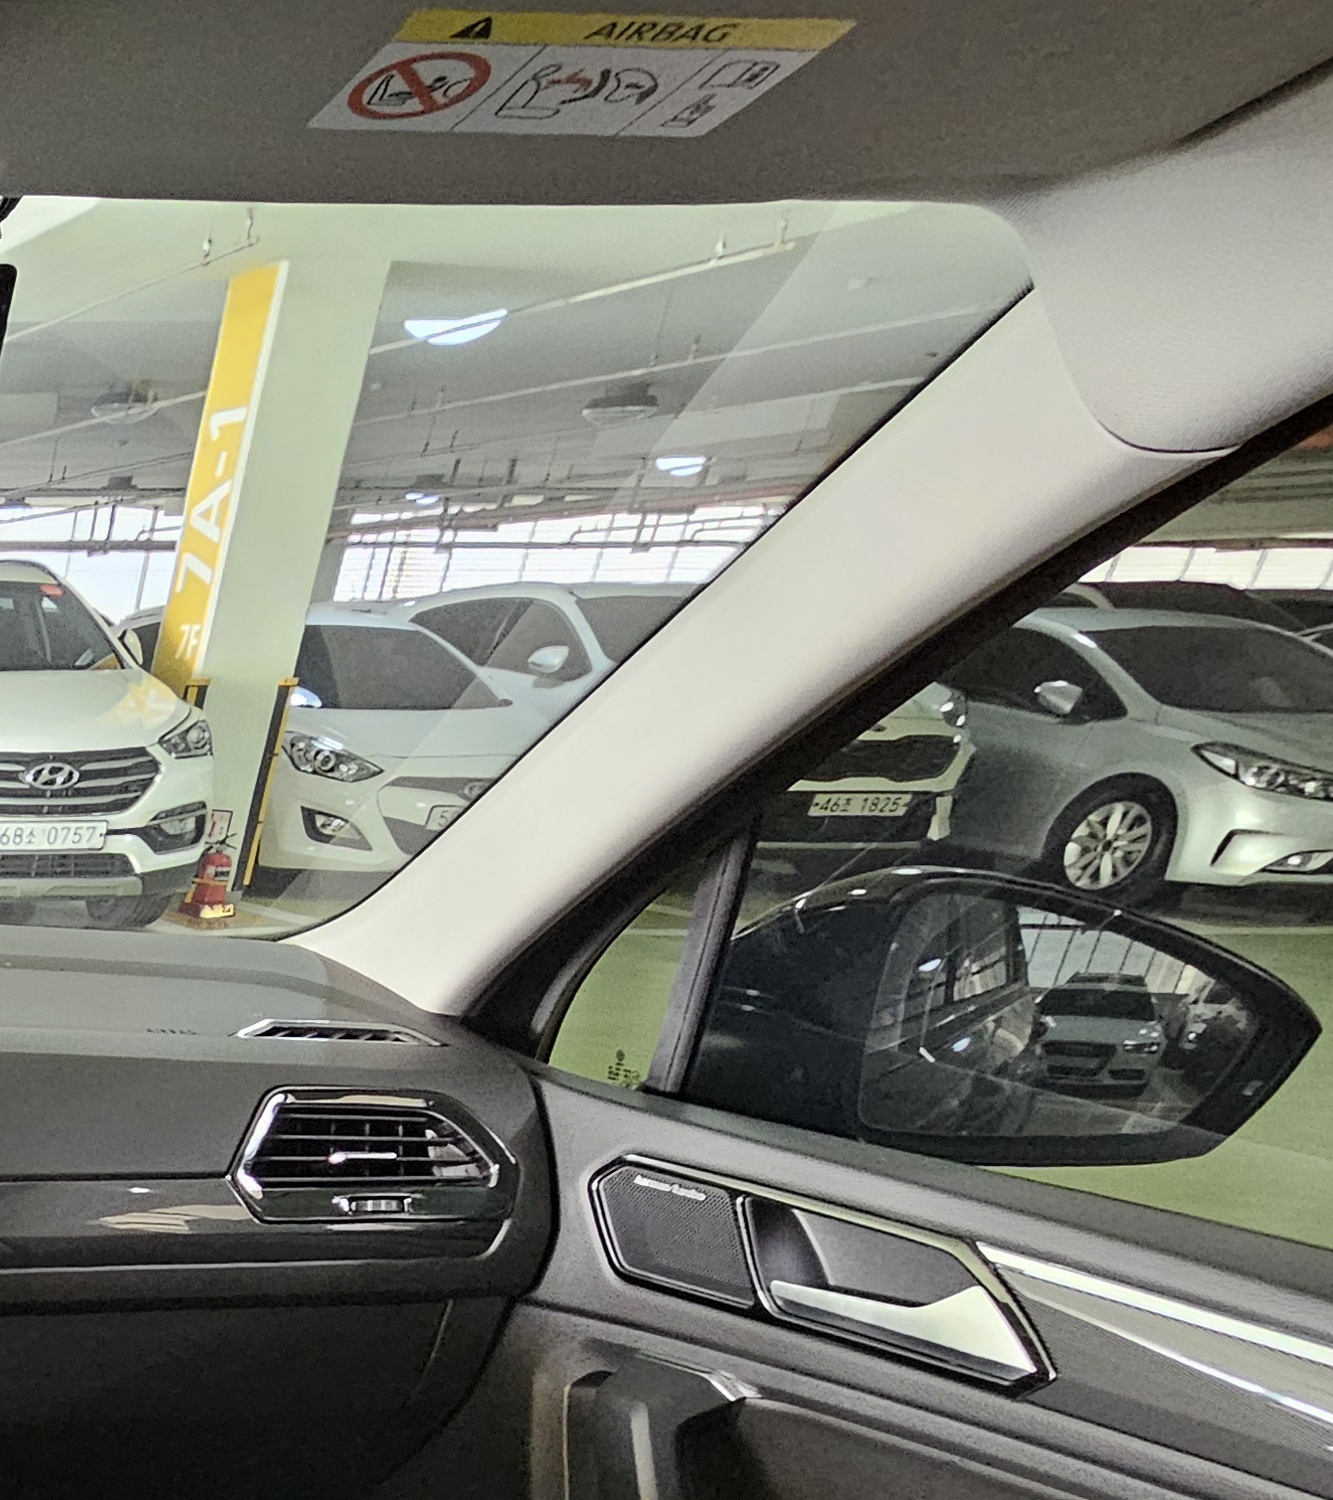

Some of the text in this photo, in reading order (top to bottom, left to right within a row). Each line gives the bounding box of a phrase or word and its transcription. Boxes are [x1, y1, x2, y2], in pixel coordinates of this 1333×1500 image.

[584, 21, 739, 43] AIRBAG
[175, 405, 247, 594] 7A-1
[174, 623, 202, 660] 7F
[859, 796, 903, 813] 1825
[46, 825, 98, 845] 0757
